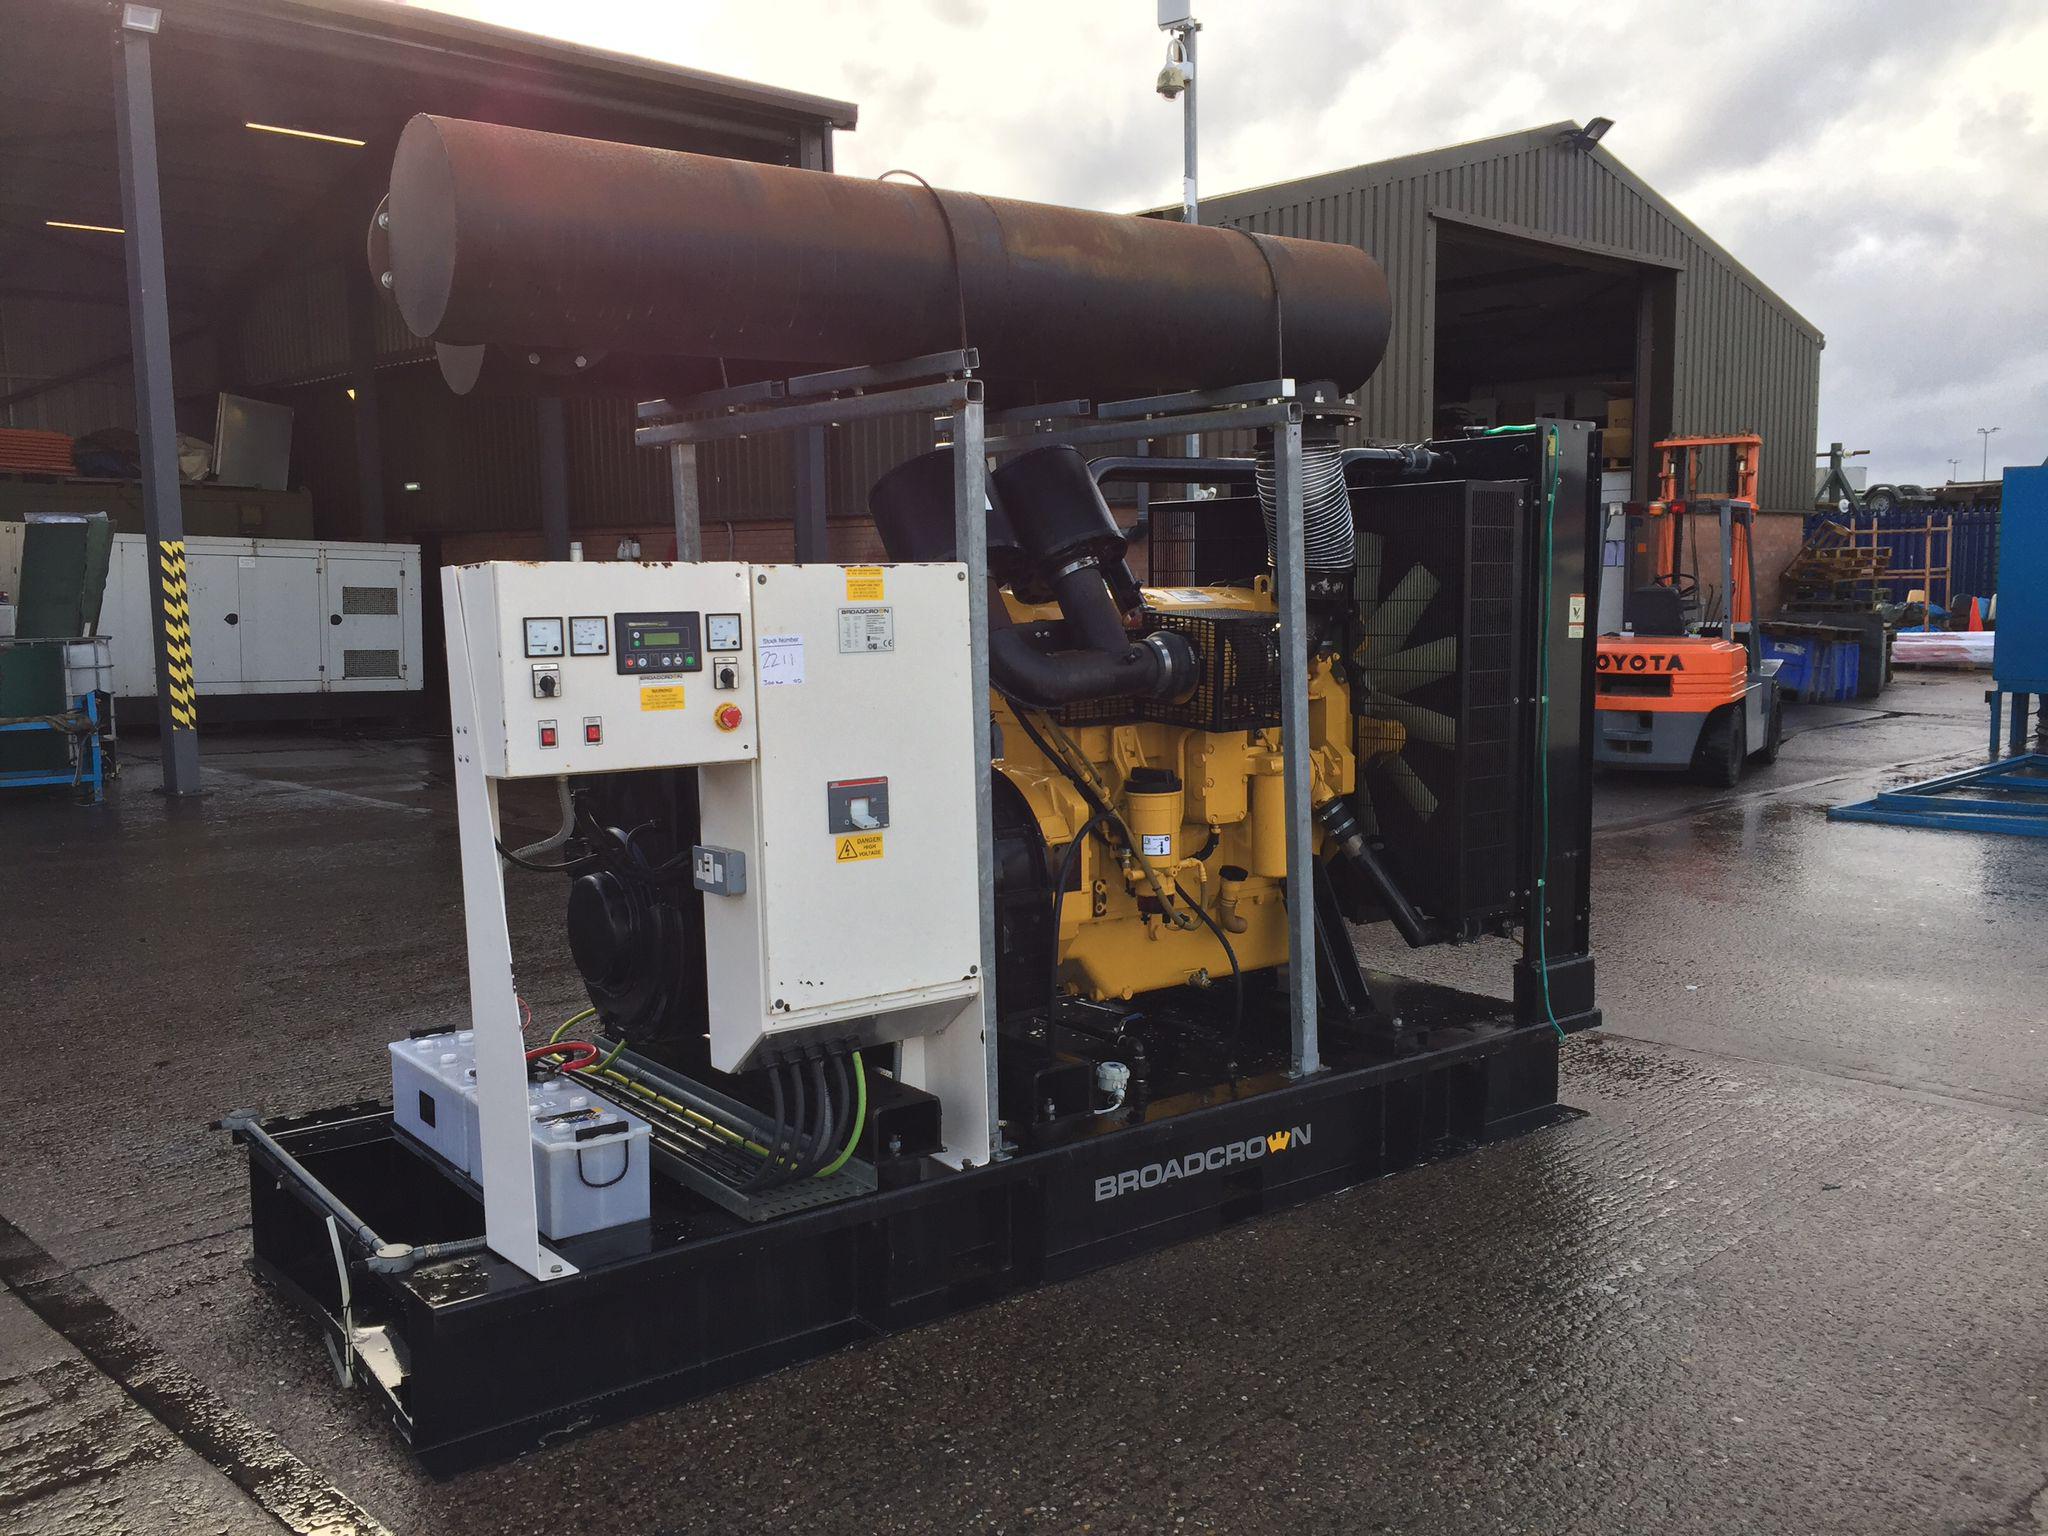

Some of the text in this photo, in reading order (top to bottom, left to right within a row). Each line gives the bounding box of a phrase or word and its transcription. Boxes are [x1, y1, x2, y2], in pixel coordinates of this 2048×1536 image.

[1596, 655, 1684, 671] OYOTA
[857, 836, 882, 845] DANGER
[1095, 1123, 1312, 1201] BROADCROWN
